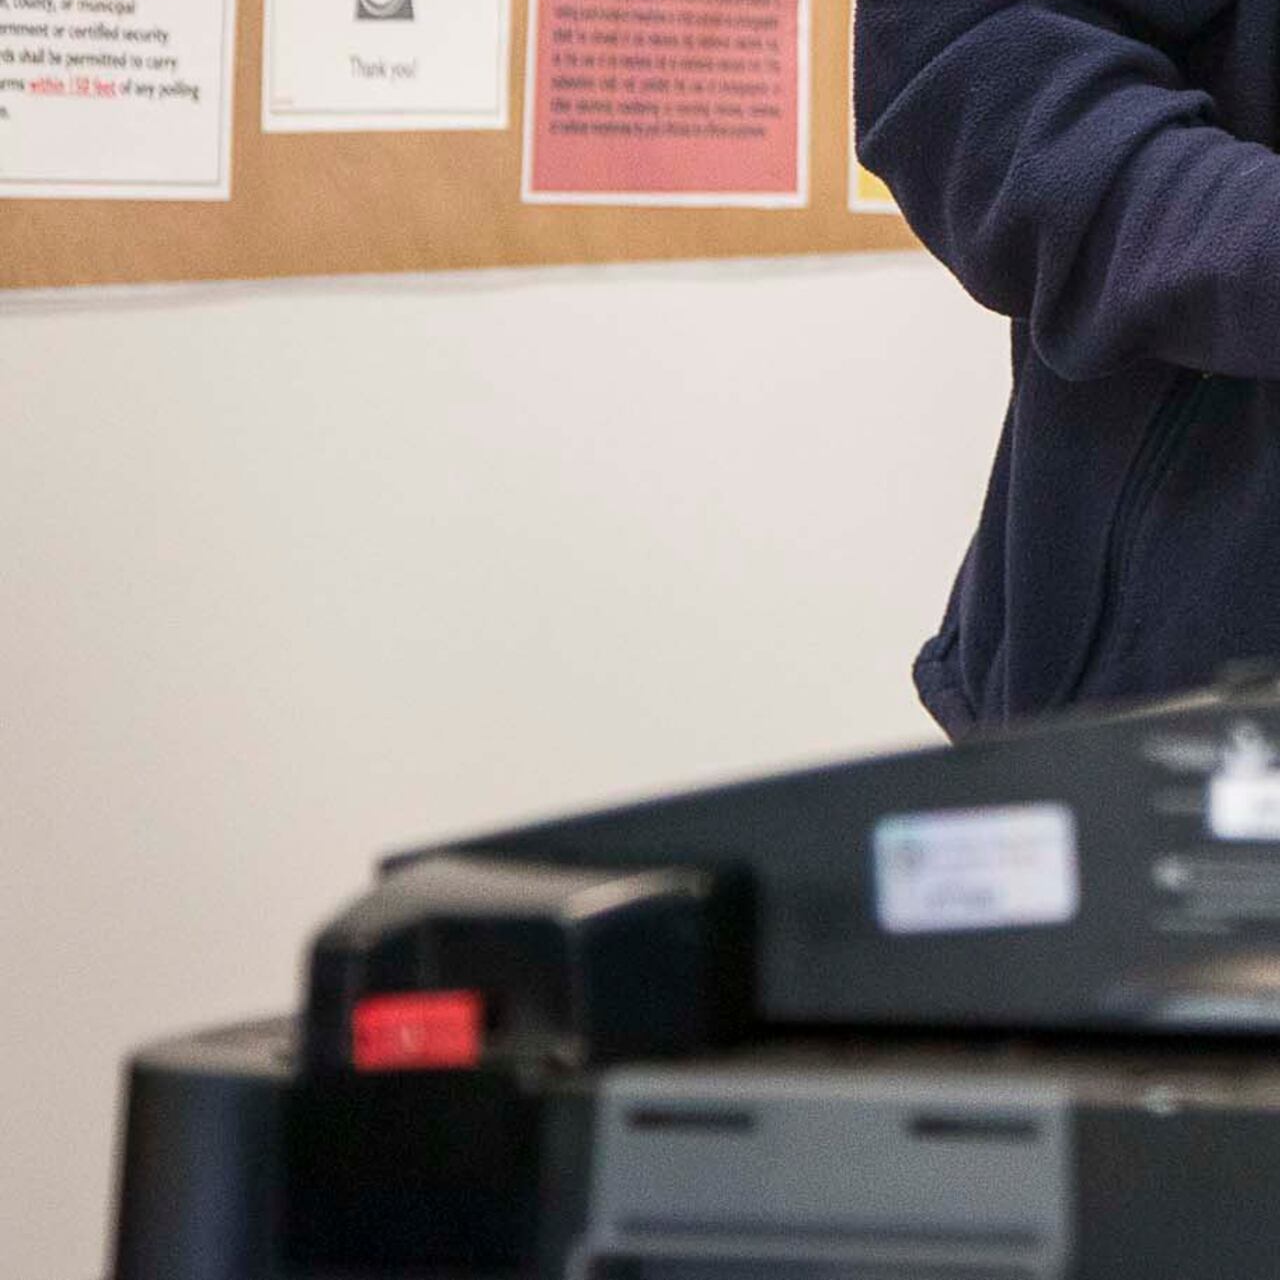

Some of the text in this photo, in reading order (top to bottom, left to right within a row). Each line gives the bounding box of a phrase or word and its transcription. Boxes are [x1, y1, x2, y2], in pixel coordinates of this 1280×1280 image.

[61, 0, 73, 10] or
[0, 23, 169, 46] ernment or certified security
[19, 47, 45, 64] shall
[49, 49, 63, 65] be
[66, 51, 127, 68] permitted
[131, 54, 142, 68] to
[145, 56, 178, 74] carry
[349, 53, 387, 78] Thank
[29, 75, 65, 94] within
[120, 78, 132, 94] of
[135, 81, 155, 97] any
[158, 80, 200, 101] polling
